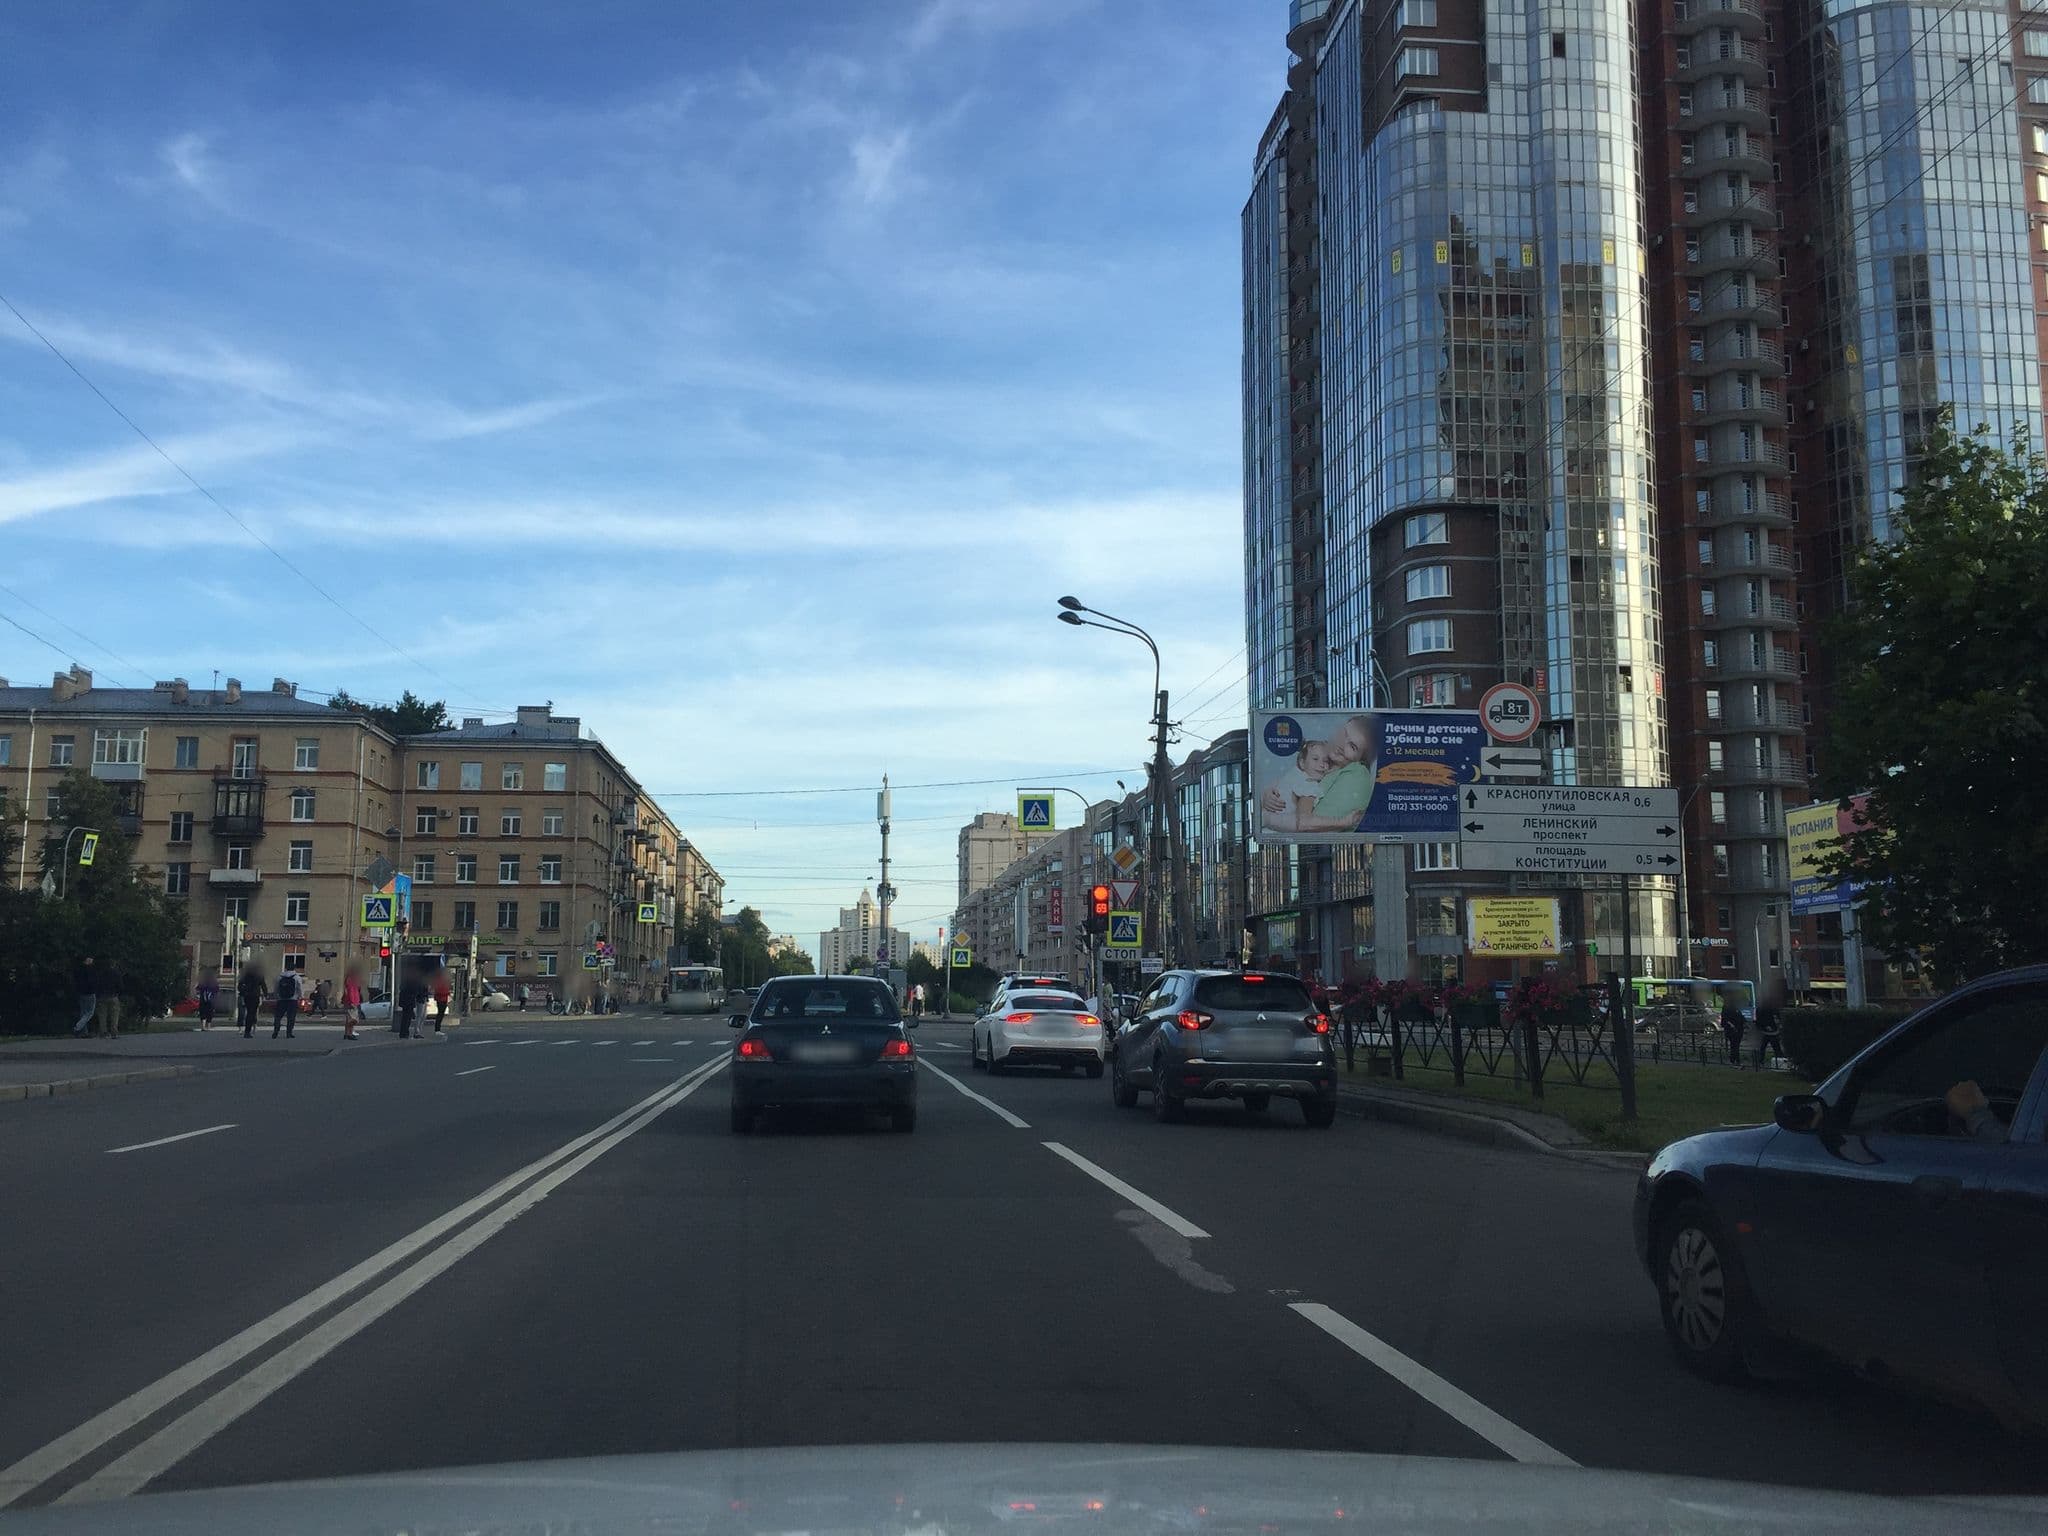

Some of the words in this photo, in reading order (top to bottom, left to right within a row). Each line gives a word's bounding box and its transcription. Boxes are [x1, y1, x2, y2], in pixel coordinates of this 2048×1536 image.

[1507, 703, 1522, 714] 8т
[1385, 723, 1425, 733] Лечим
[1427, 725, 1478, 734] детские
[1385, 733, 1421, 745] зубки
[1424, 736, 1439, 744] во
[1441, 736, 1463, 744] сне
[1393, 747, 1402, 755] 12
[1404, 748, 1446, 756] месяцев
[1388, 794, 1438, 802] Варшавская
[1487, 788, 1630, 802] КРАСНОПУТИЛОВСКАЯ
[1388, 802, 1408, 812] (812)
[1409, 803, 1448, 811] 331-0000
[1541, 802, 1576, 813] улица
[1522, 817, 1597, 829] ЛЕНИНСКИЙ
[1789, 817, 1834, 837] ИСПАНИЯ
[1533, 831, 1588, 841] проспект
[1535, 846, 1586, 857] площадь
[1515, 857, 1607, 870] КОНСТИТУЦИИ
[1096, 903, 1107, 913] 69
[1105, 949, 1137, 959] СТОП
